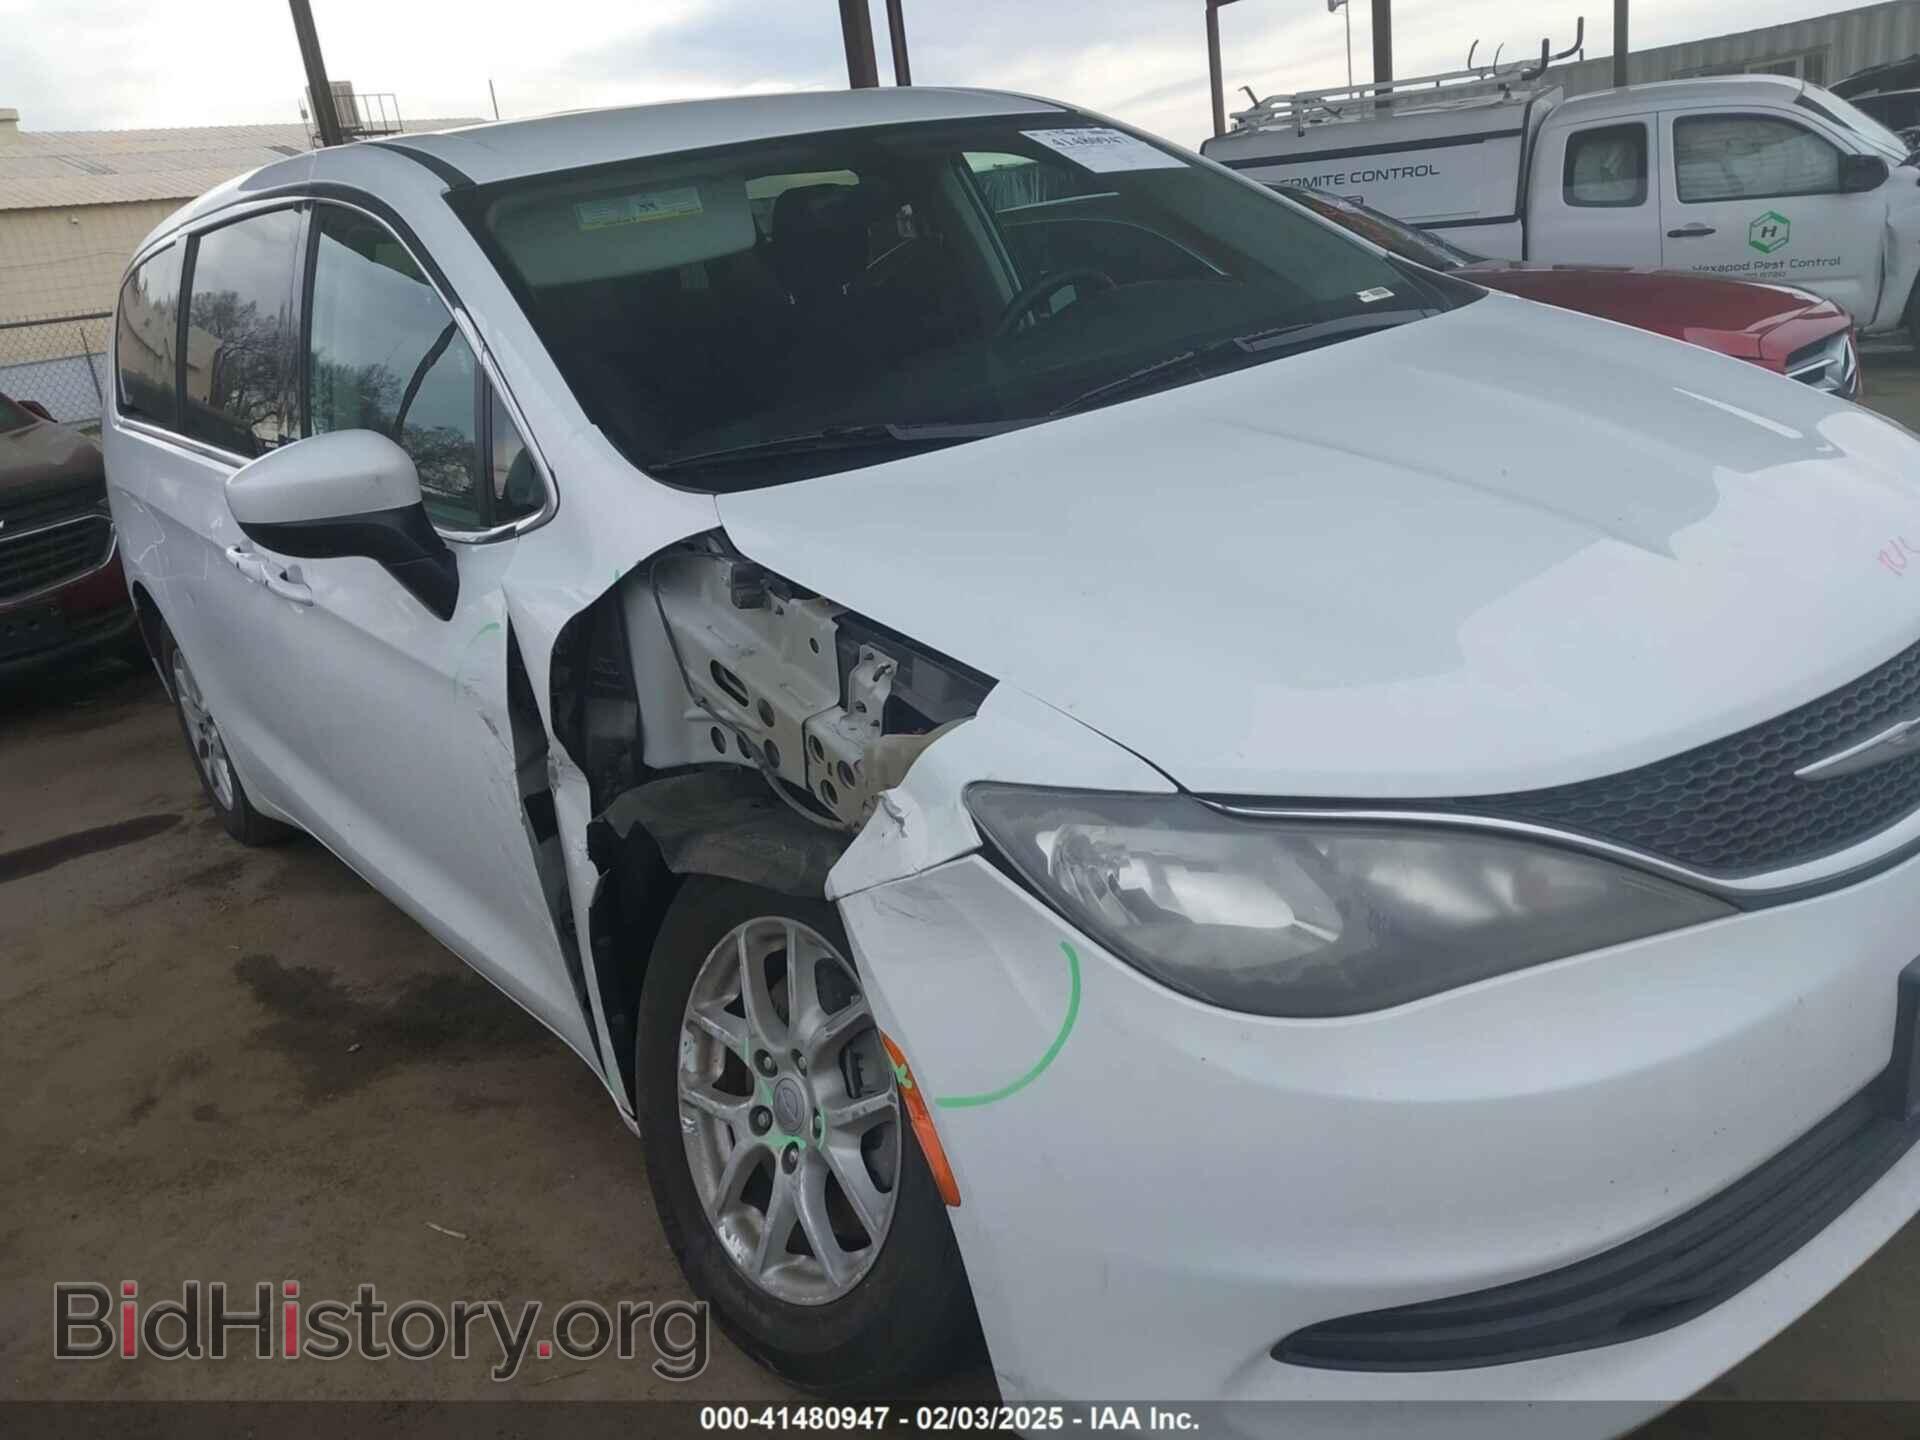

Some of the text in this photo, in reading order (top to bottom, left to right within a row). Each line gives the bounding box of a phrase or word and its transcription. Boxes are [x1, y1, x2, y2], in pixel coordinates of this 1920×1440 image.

[1350, 164, 1441, 183] CONTROL
[1761, 225, 1778, 238] H
[1754, 259, 1785, 270] Pest
[1790, 255, 1841, 268] Control
